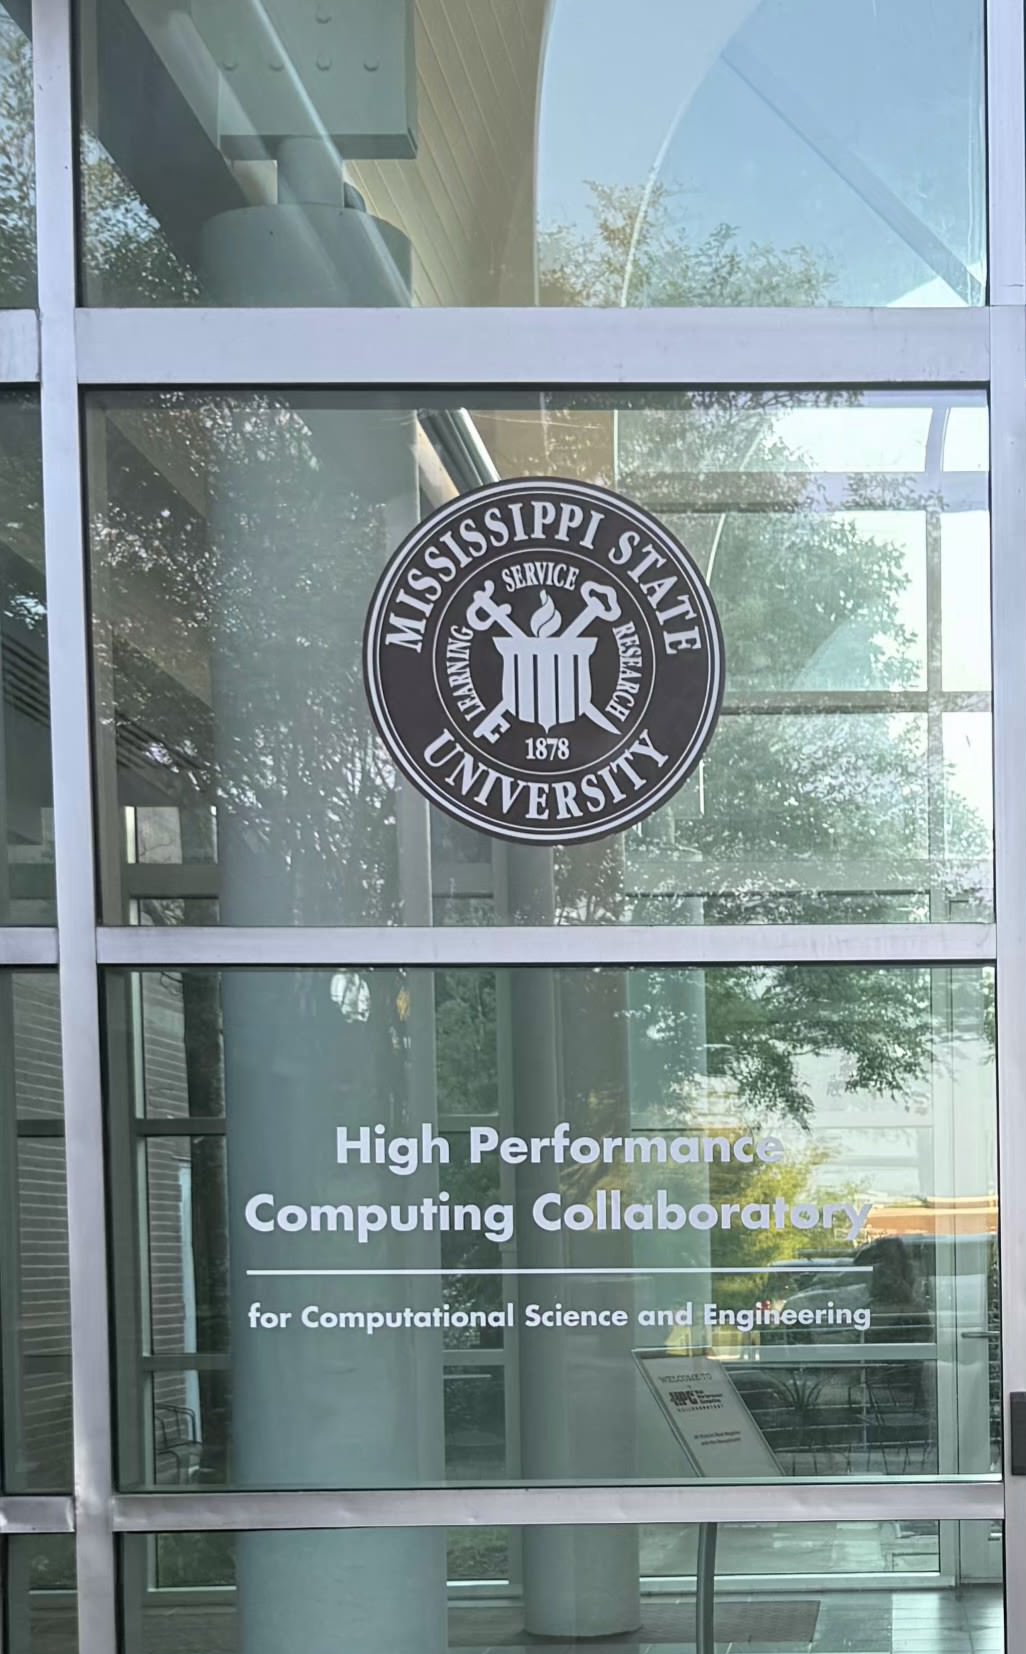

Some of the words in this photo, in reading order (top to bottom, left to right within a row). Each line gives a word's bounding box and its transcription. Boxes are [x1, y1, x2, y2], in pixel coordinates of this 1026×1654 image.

[385, 500, 605, 654] MISSISSIPPI
[607, 530, 702, 655] STATE
[501, 561, 579, 593] SERVICE
[446, 625, 486, 721] LEARNING
[612, 620, 643, 723] RESEARCH
[423, 728, 669, 821] UNIVERSITY
[524, 737, 570, 761] 1878
[336, 1122, 450, 1175] High
[469, 1122, 785, 1164] Performance
[244, 1191, 515, 1243] Computing
[532, 1189, 874, 1241] Collaboratory
[248, 1302, 292, 1329] for
[301, 1302, 515, 1335] Computational
[524, 1303, 629, 1327] Science
[637, 1301, 693, 1327] and
[703, 1300, 872, 1333] Engineering
